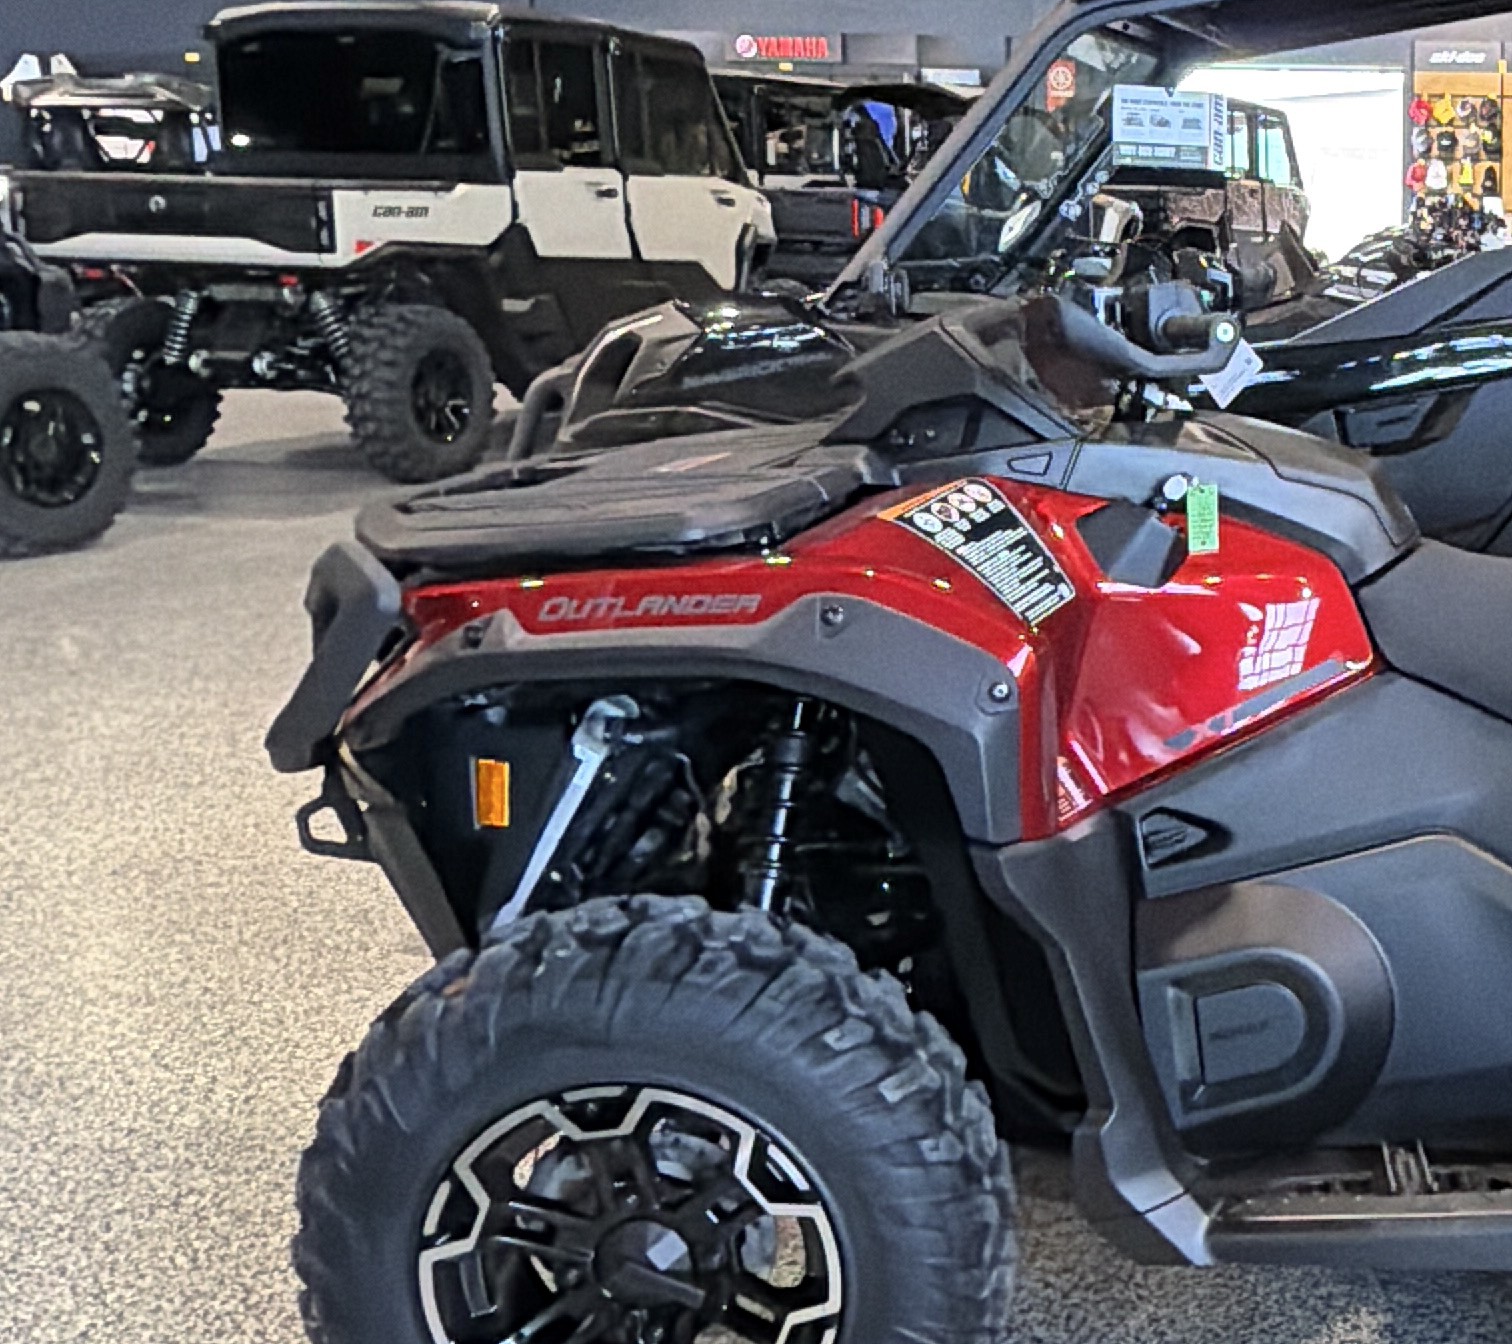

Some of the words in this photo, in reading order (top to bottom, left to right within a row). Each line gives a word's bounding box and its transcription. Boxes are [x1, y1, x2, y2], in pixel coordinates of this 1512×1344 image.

[756, 36, 829, 59] YAMAHA
[372, 205, 430, 217] can-am
[537, 594, 762, 622] OUTLANDER
